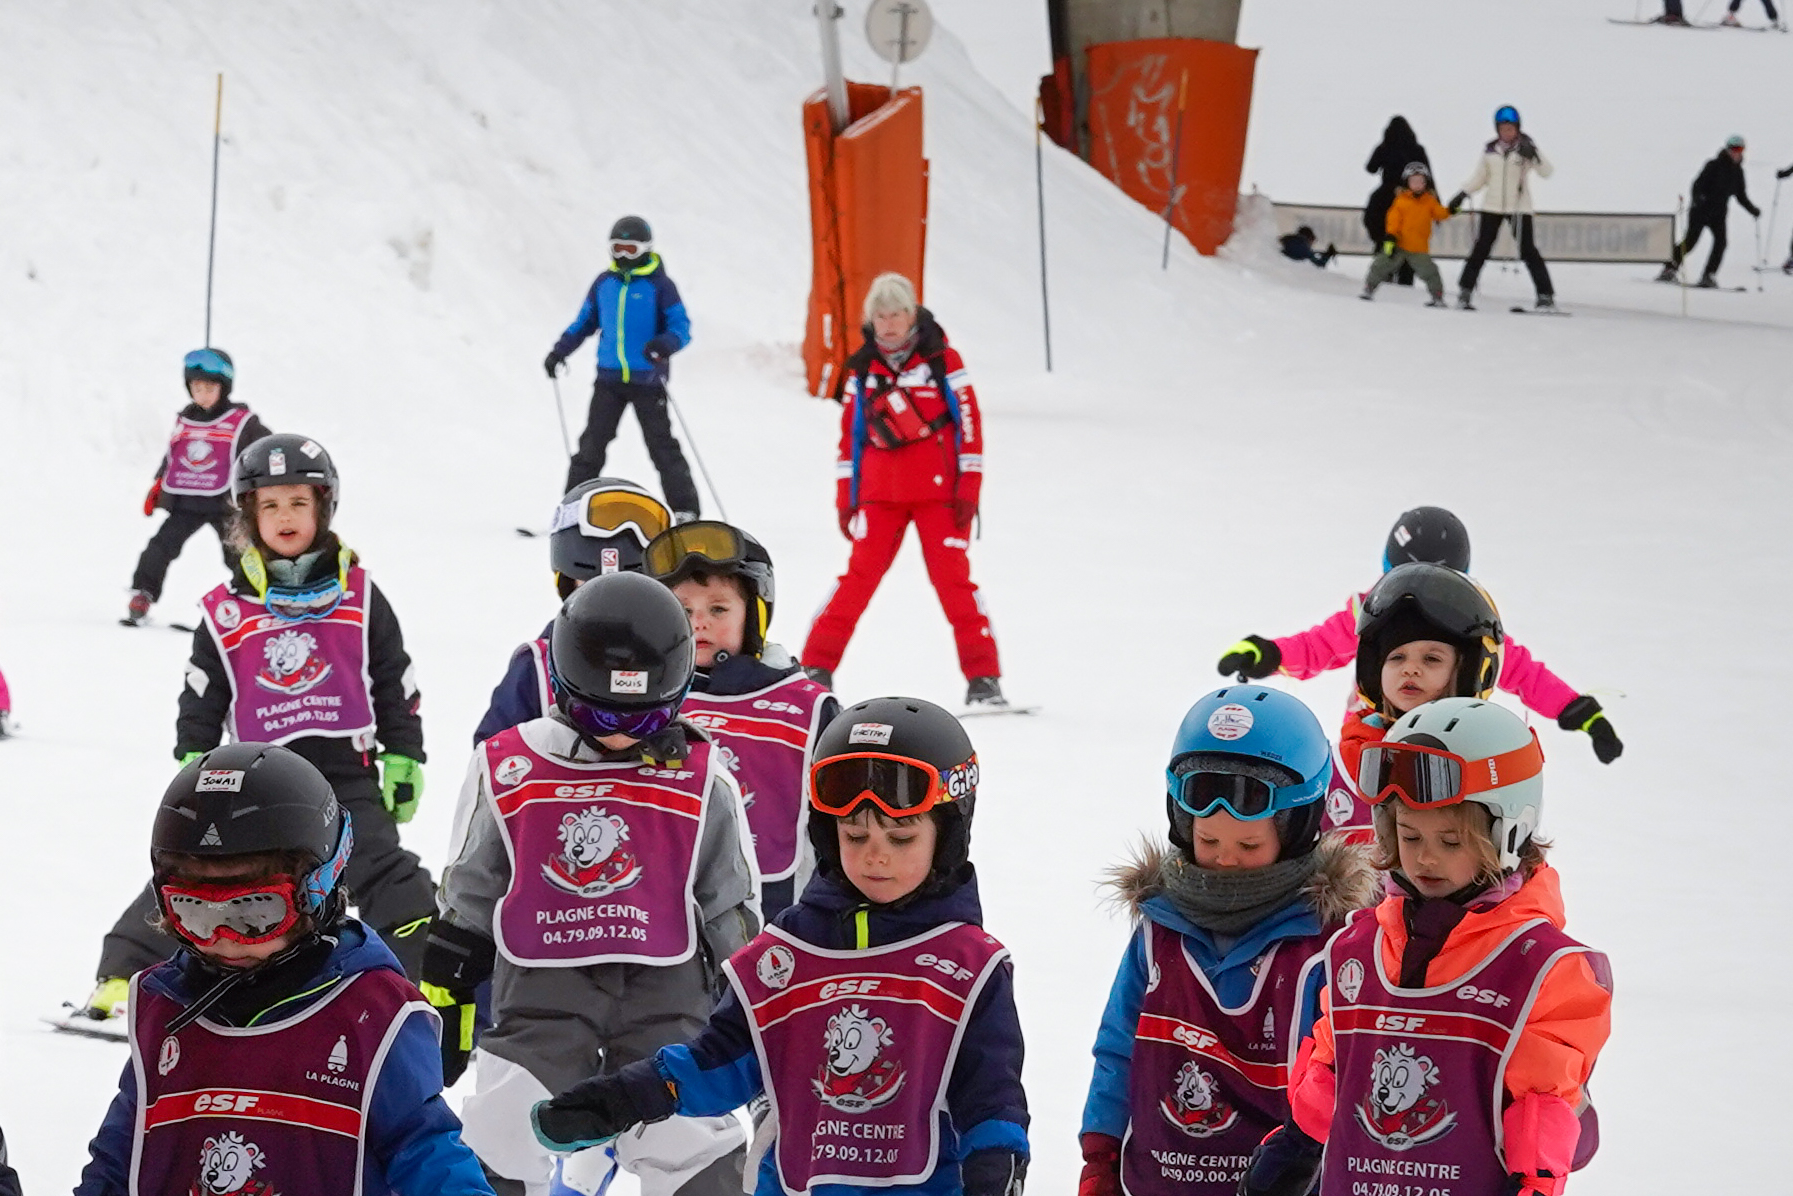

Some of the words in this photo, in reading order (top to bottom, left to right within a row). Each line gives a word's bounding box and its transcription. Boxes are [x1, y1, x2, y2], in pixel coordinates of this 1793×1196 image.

[536, 904, 596, 925] PLAGNE
[597, 903, 649, 924] CENTRE
[543, 925, 647, 944] 04.79.09.12.05
[306, 1071, 318, 1081] LA
[320, 1074, 360, 1091] PLAGNE
[852, 1123, 905, 1139] CENTRE
[1347, 1156, 1396, 1175] PLAGNE
[1396, 1160, 1461, 1180] CENTRE
